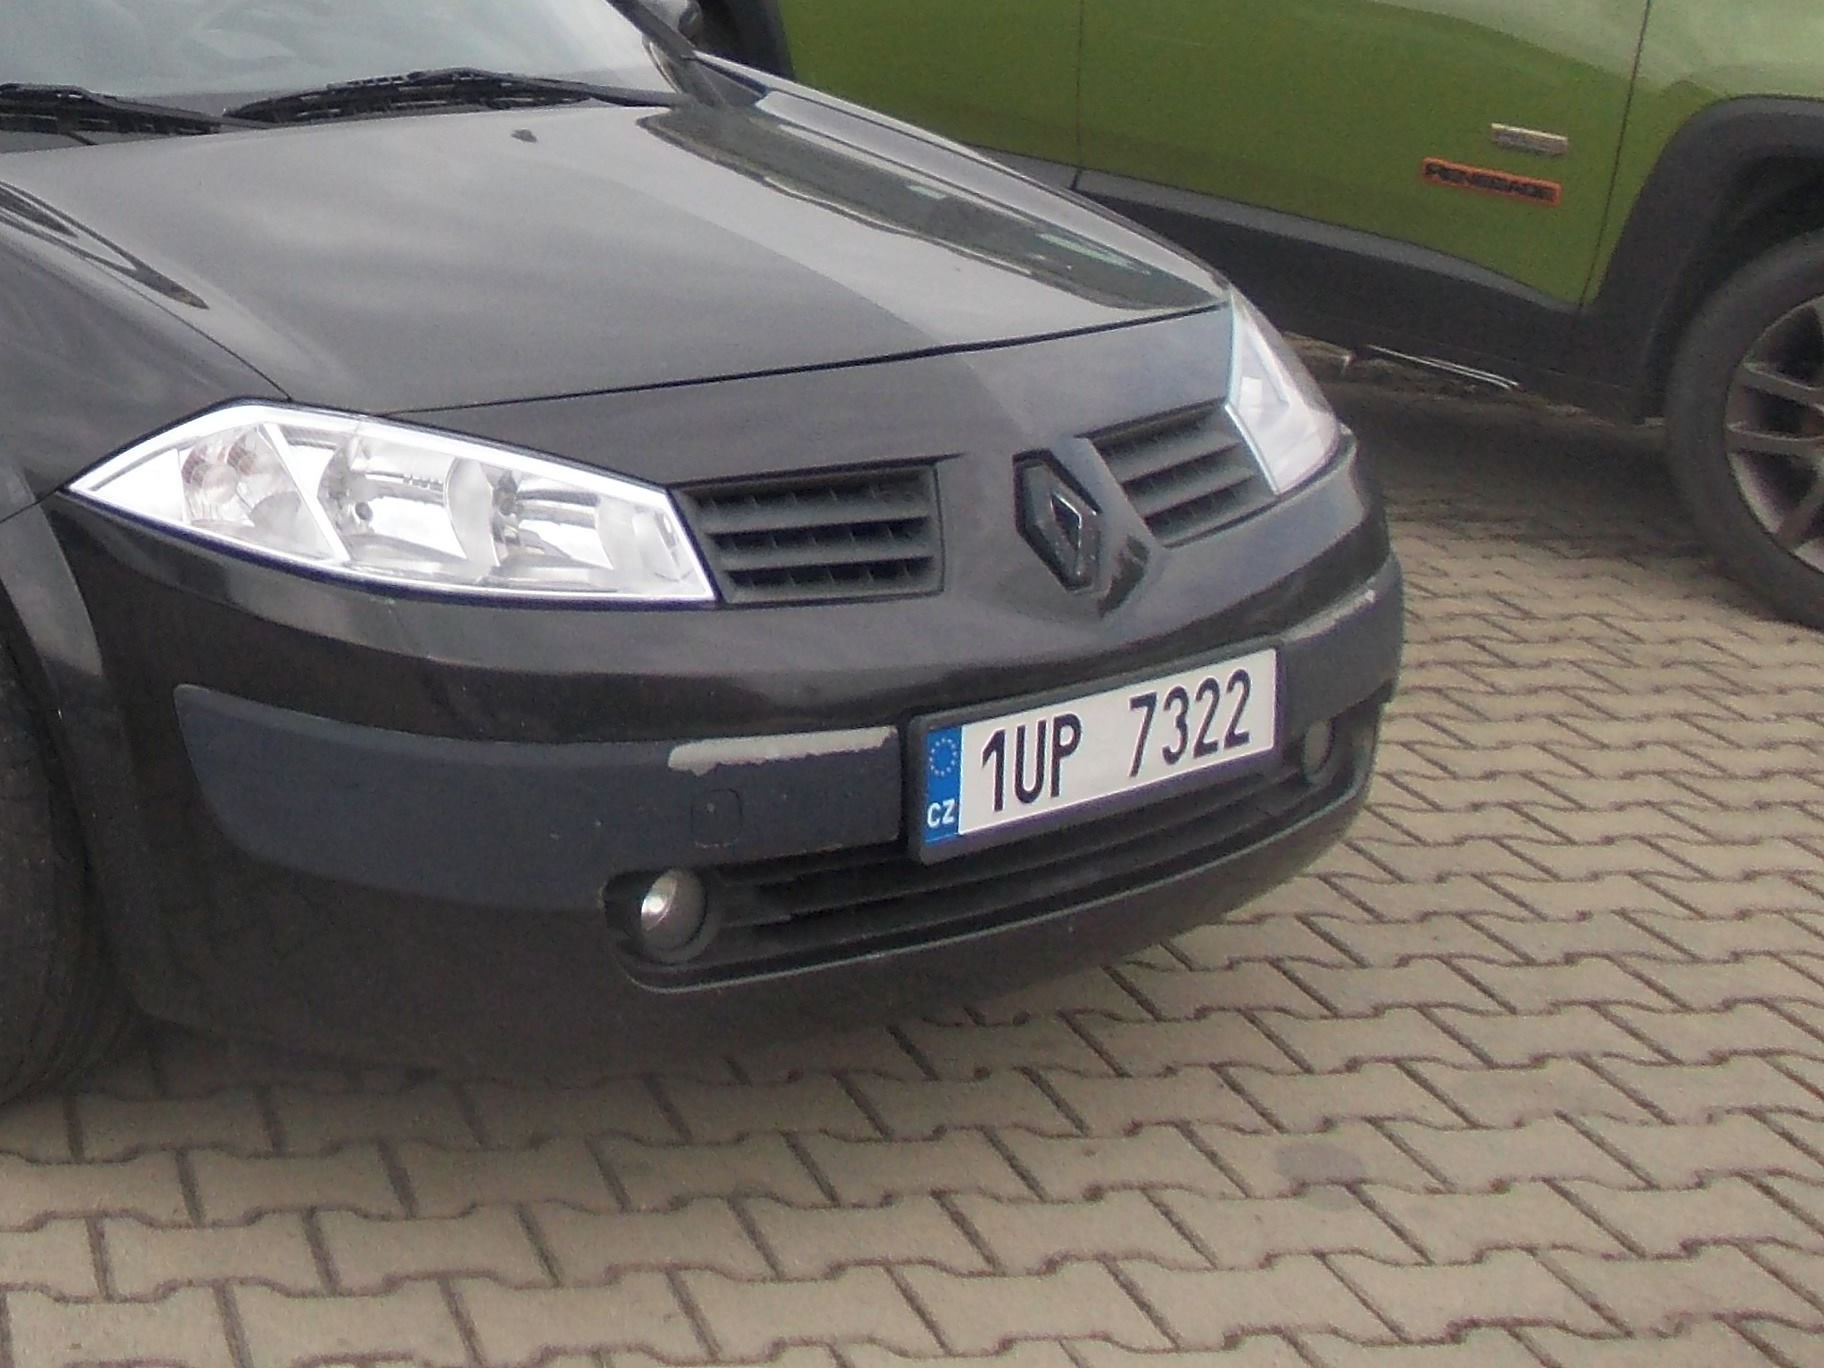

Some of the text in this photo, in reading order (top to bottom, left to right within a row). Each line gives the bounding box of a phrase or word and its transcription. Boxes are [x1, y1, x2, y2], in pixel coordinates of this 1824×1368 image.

[981, 668, 1252, 812] 1UP 7322
[926, 798, 956, 829] CZ
